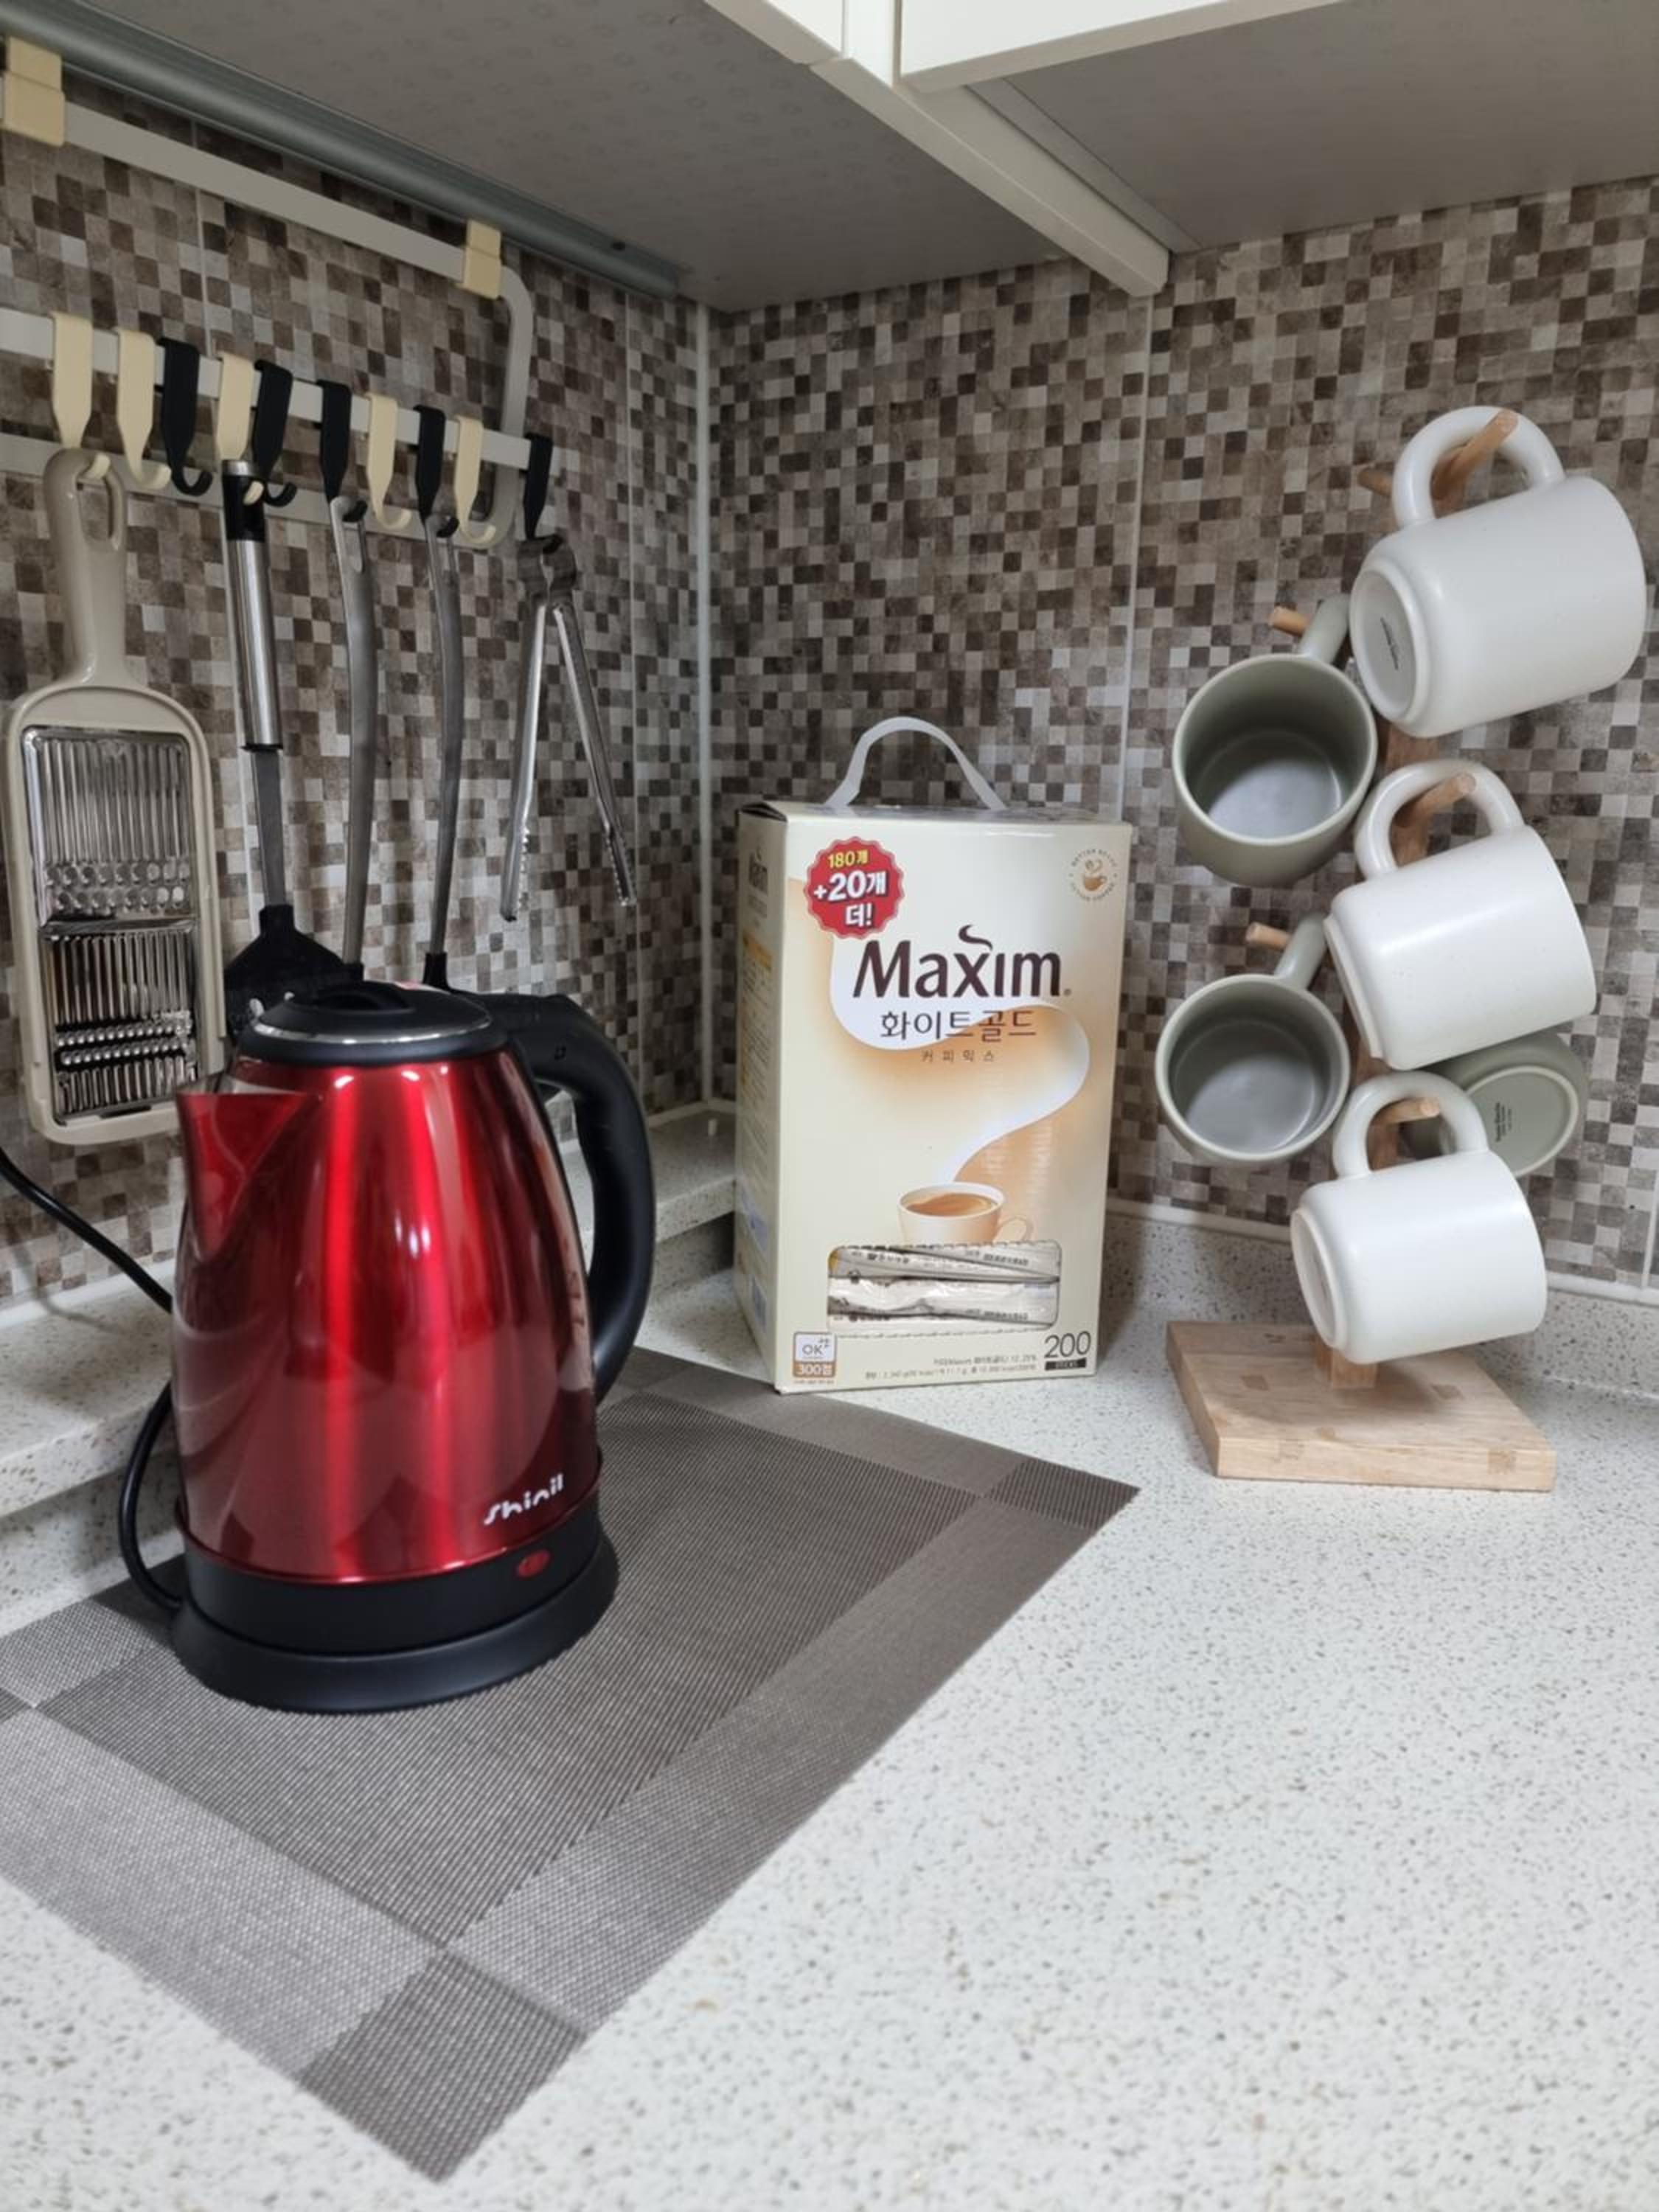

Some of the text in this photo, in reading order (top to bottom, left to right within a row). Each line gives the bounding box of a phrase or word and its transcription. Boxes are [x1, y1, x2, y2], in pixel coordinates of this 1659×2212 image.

[828, 849, 869, 869] 180개
[813, 870, 887, 901] +20개
[845, 902, 873, 927] 더!
[852, 925, 1061, 998] Maxim
[880, 1010, 1037, 1043] 화이트골드
[1044, 1330, 1092, 1359] 200
